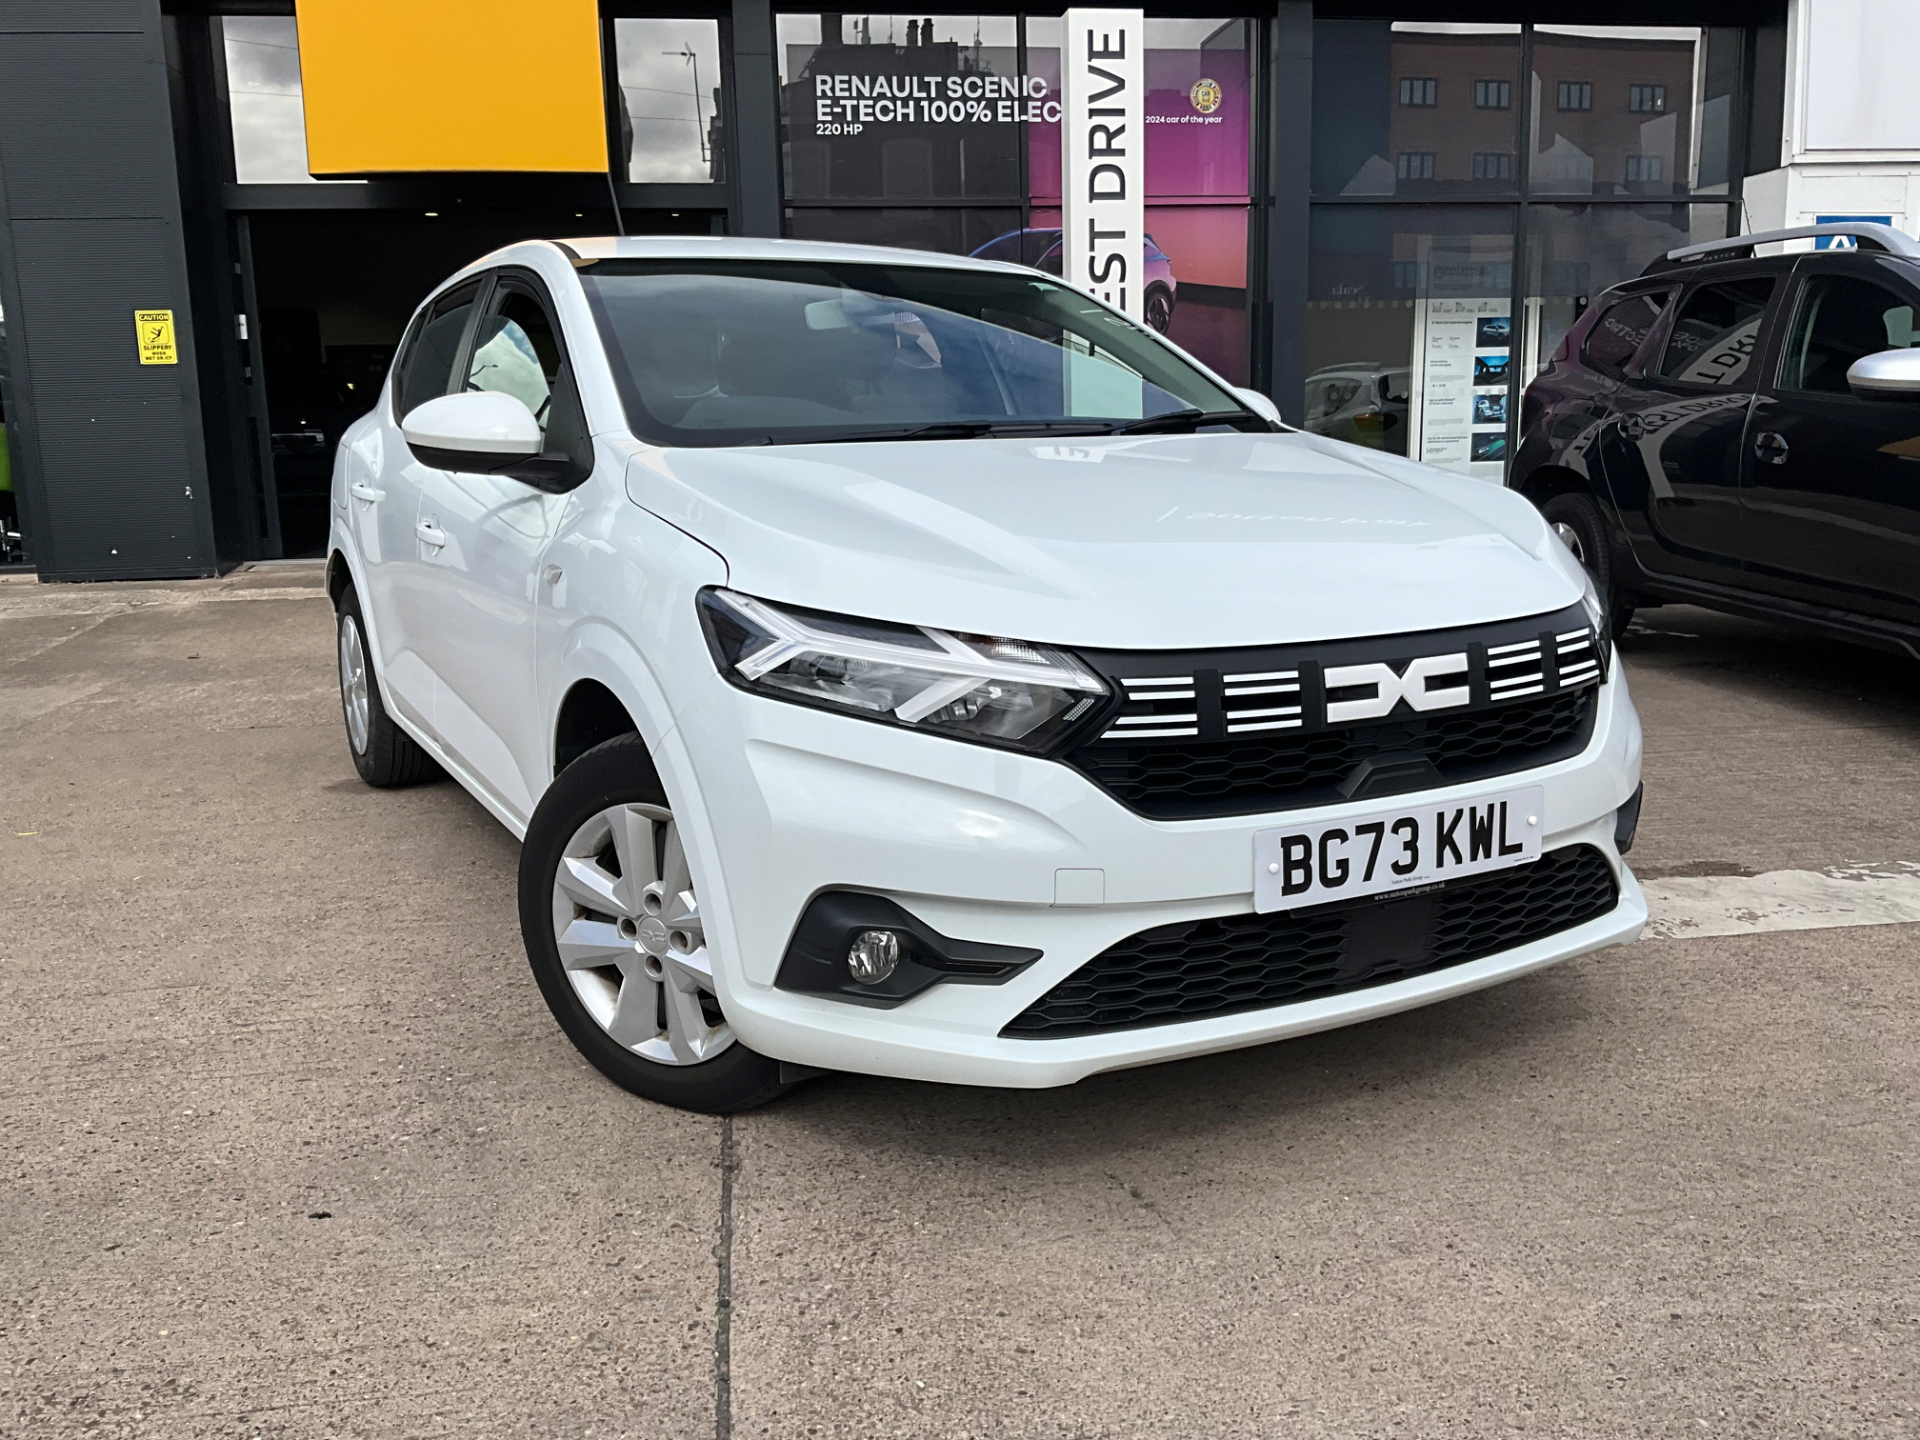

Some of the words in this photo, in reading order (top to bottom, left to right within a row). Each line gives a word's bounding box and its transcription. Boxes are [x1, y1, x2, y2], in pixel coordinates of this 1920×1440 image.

[816, 75, 942, 97] RENAULT
[947, 75, 1048, 98] SCENIC
[817, 100, 915, 121] E-TECH
[920, 101, 992, 122] 100%
[1088, 28, 1126, 202] DRIVE
[1180, 115, 1189, 123] of
[1190, 115, 1204, 123] the
[1204, 117, 1223, 125] year
[816, 124, 841, 135] 220
[843, 124, 863, 135] HP
[1280, 816, 1419, 897] BG73
[1436, 801, 1523, 869] KWL
